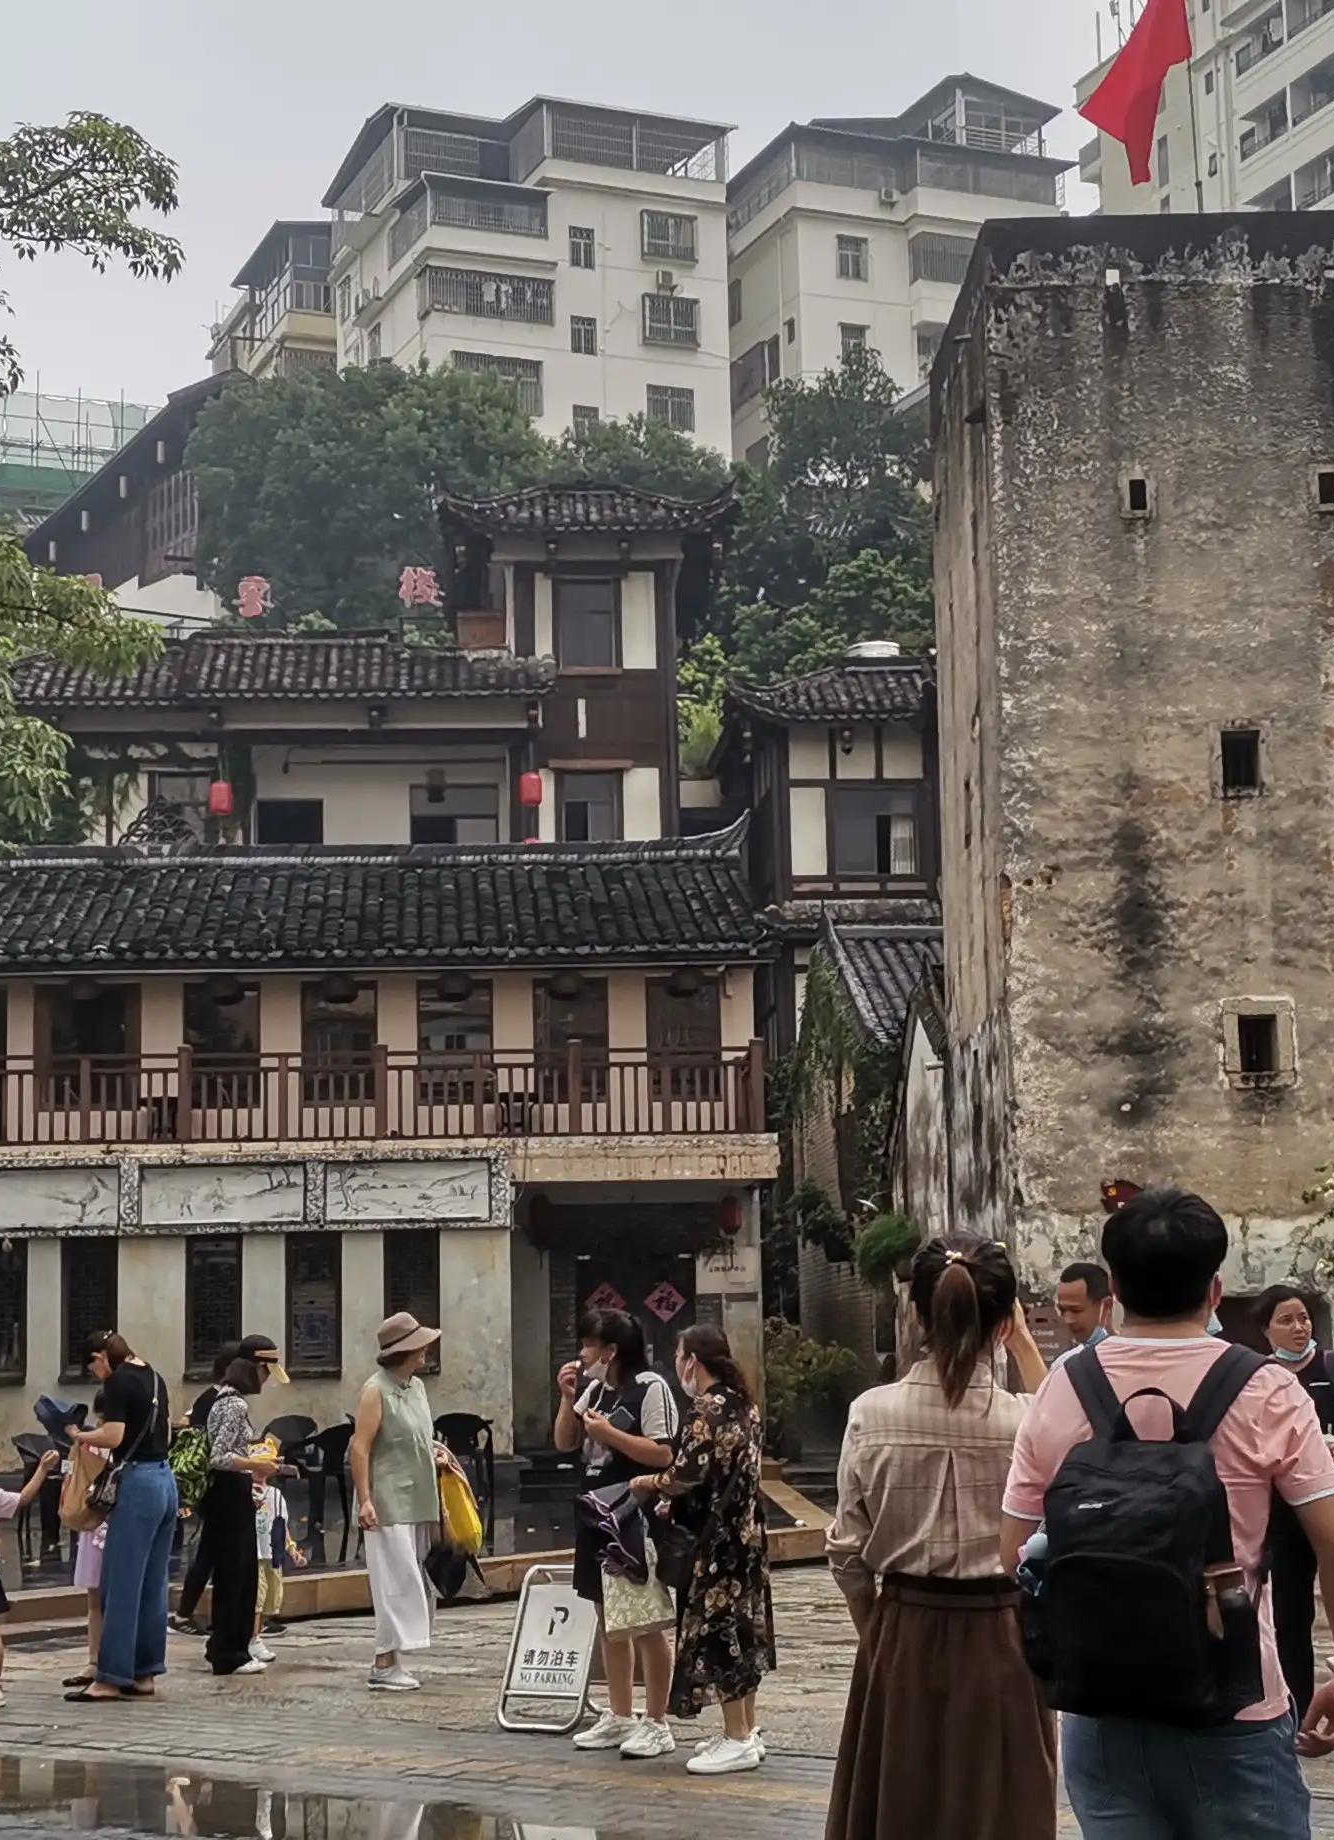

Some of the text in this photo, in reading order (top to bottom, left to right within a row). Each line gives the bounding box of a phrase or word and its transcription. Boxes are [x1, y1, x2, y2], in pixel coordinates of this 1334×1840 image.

[651, 1289, 678, 1312] 福
[522, 1648, 580, 1668] 请勿泊车
[519, 1671, 575, 1685] NO PARKING
